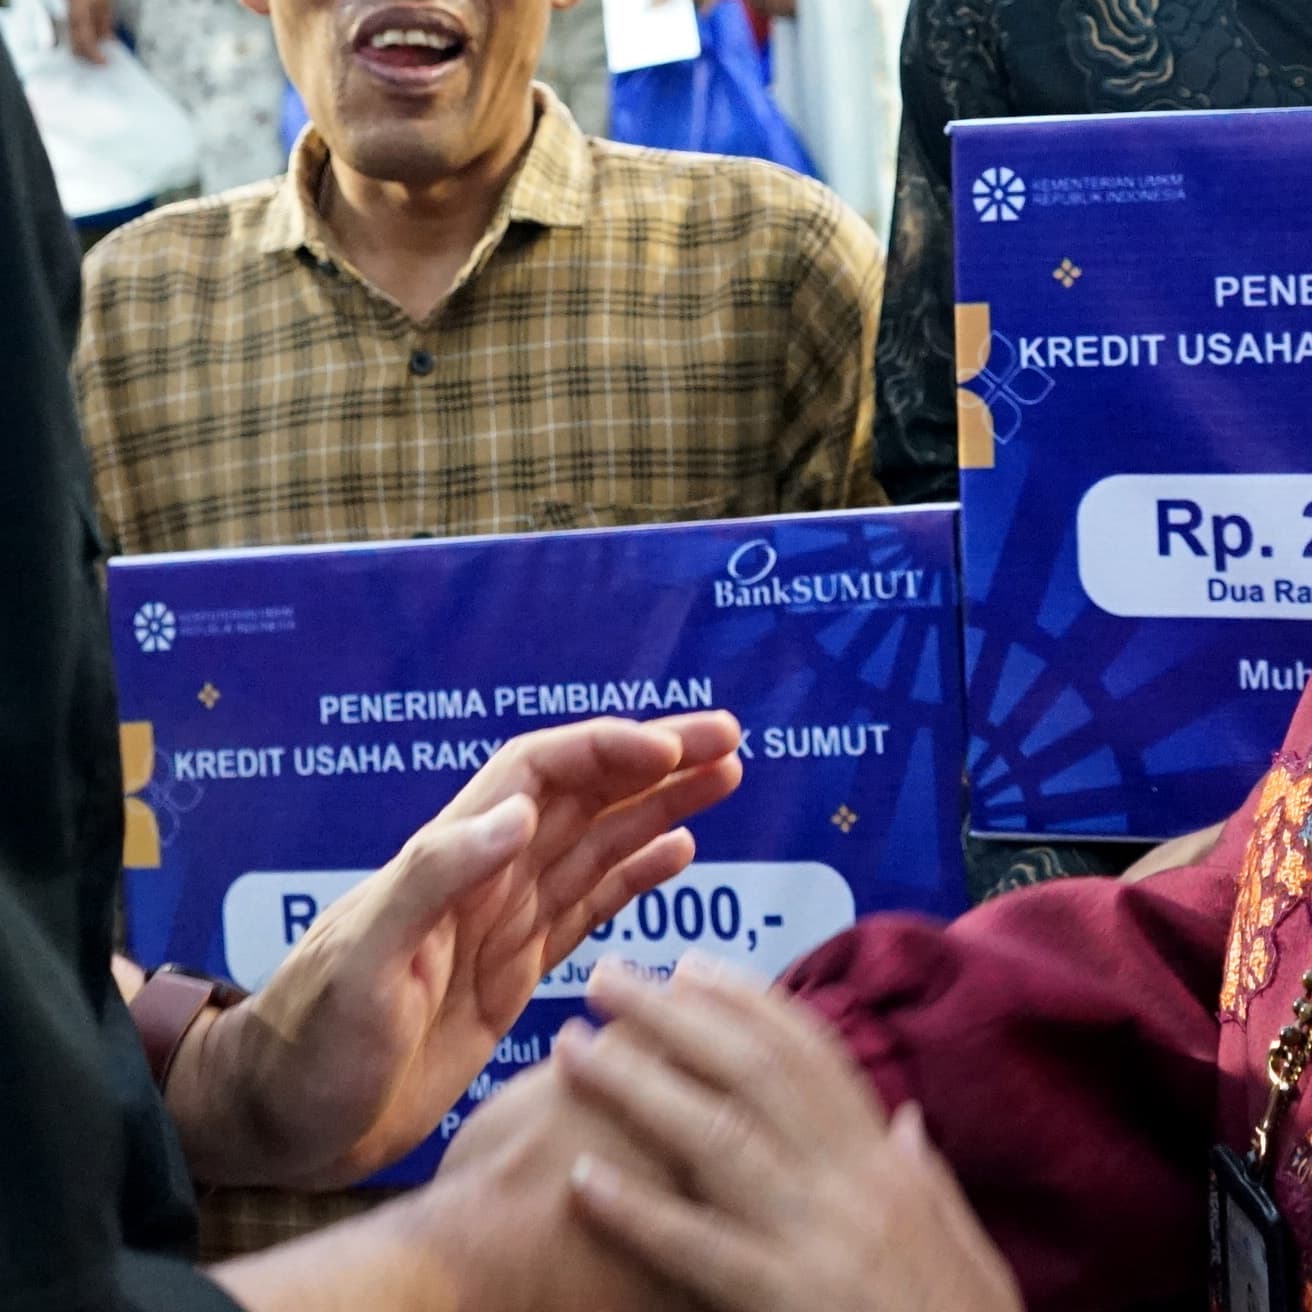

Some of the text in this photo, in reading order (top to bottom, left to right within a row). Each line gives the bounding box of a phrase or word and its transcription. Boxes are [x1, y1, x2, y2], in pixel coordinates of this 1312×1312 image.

[1019, 334, 1165, 368] KREDIT
[1156, 499, 1274, 572] Rp.
[1207, 578, 1265, 603] Dua
[319, 677, 713, 725] PENERIMA PEMBIAYAAN
[765, 723, 890, 759] SUMUT
[174, 747, 286, 781] KREDIT
[293, 742, 405, 777] USAHA
[494, 1035, 541, 1064] dul
